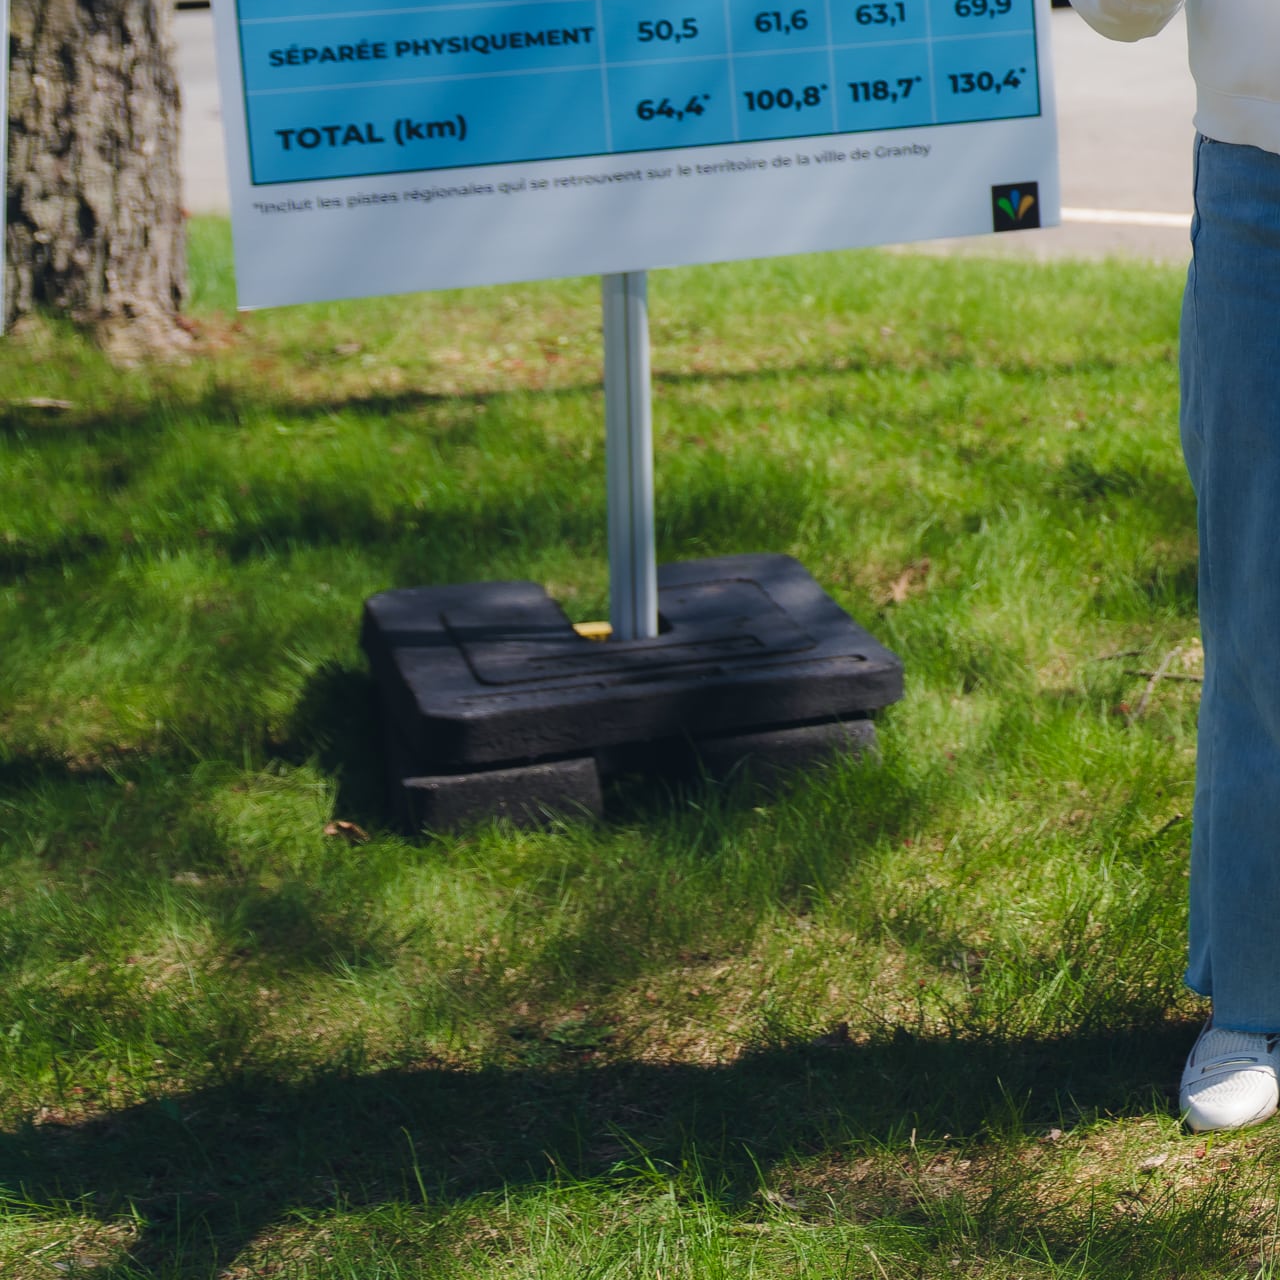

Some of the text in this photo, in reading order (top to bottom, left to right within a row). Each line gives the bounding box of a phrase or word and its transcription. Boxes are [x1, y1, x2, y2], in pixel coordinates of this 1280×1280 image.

[637, 17, 699, 45] 50,5
[754, 8, 808, 35] 61,6
[855, 2, 905, 29] 63,1
[268, 26, 595, 68] SÉPARÉE PHYSIQUEMENT
[275, 114, 468, 151] TOTAL (km)
[317, 196, 342, 210] les
[346, 191, 399, 210] pistes
[403, 182, 494, 205] régionales
[498, 178, 526, 196] qui
[530, 178, 549, 190] se
[553, 167, 643, 187] retrouvent
[647, 168, 674, 181] sur
[677, 163, 691, 177] le
[696, 158, 768, 177] territoire
[771, 154, 791, 169] de
[796, 152, 809, 166] la
[814, 149, 847, 165] ville
[850, 146, 869, 161] de
[874, 143, 931, 162] Granby
